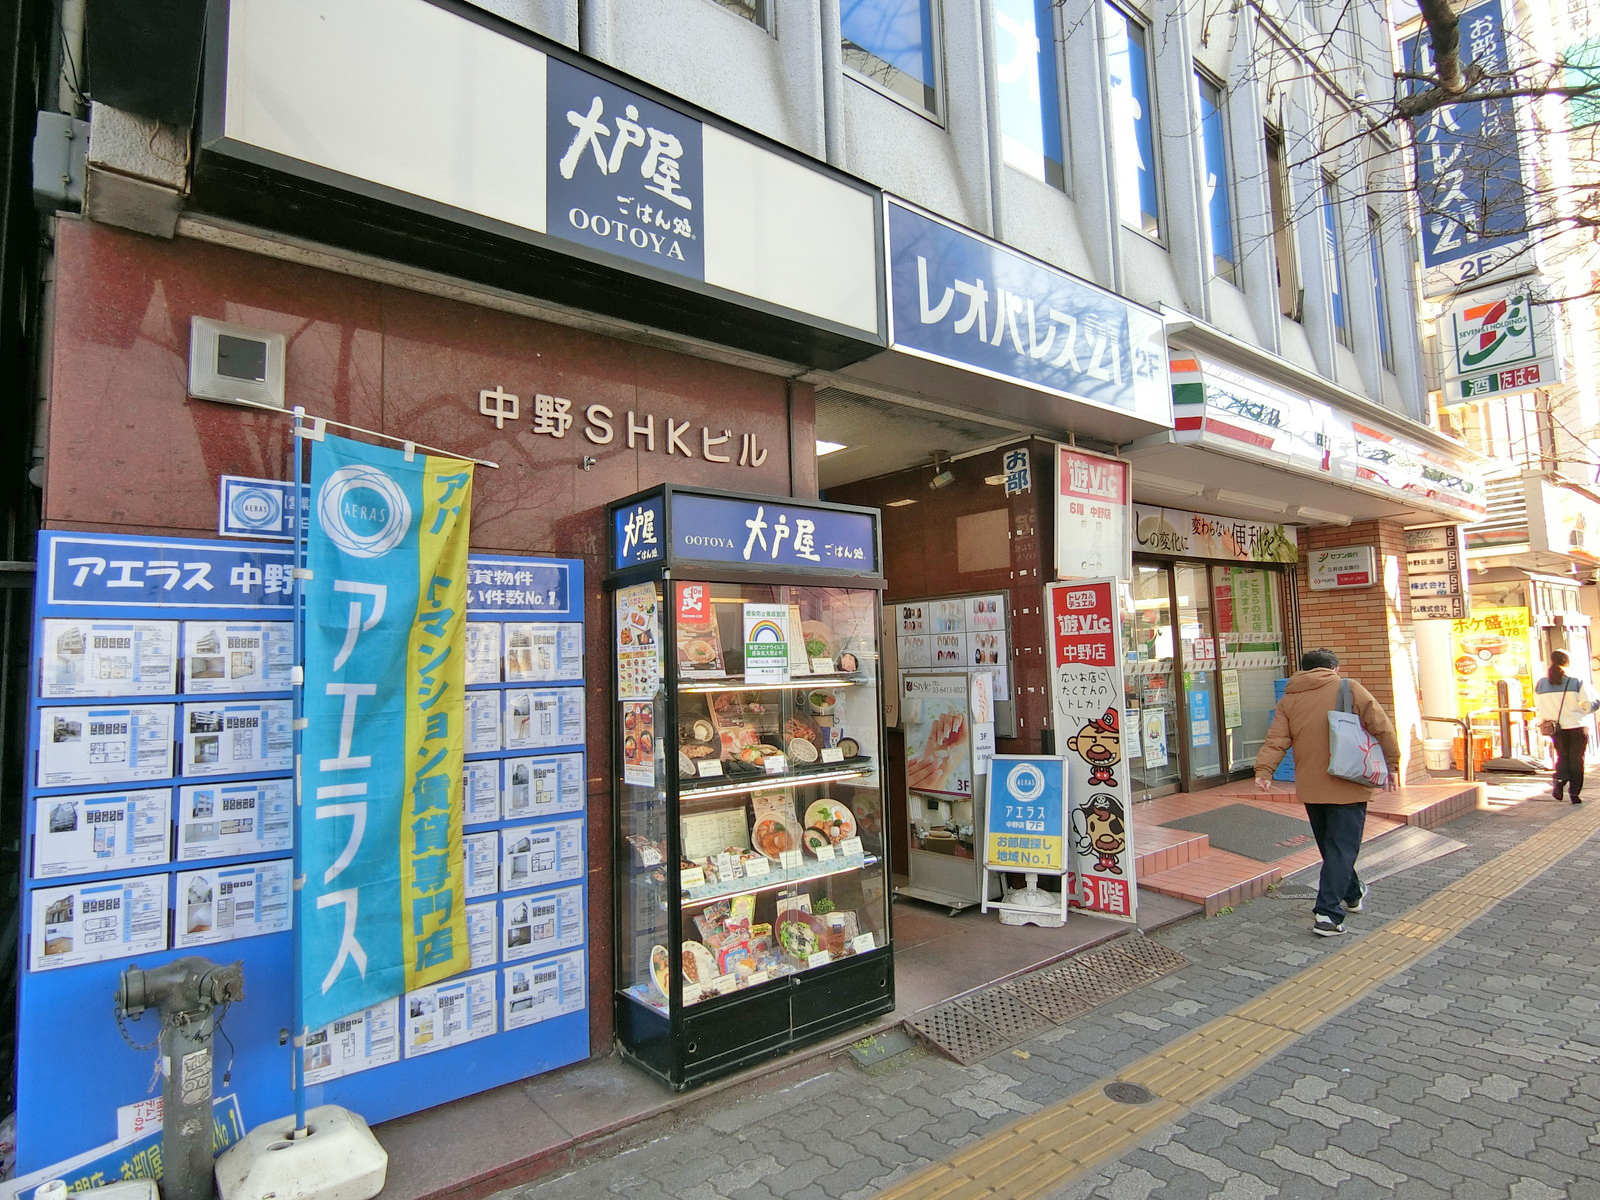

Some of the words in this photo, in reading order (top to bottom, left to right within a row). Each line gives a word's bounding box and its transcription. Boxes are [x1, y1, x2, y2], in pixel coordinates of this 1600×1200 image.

[559, 96, 693, 211] 大戸屋
[617, 195, 692, 239] ごはん処
[568, 208, 686, 262] OOTOYA
[1459, 254, 1493, 281] 2F
[1490, 315, 1528, 333] HOLDINGS
[1468, 377, 1490, 396] 酒
[1501, 366, 1540, 389] たばこ
[478, 385, 770, 469] 中野SHKビル
[244, 504, 268, 513] AERAS
[344, 502, 387, 523] AERAS
[1069, 502, 1085, 516] 6階
[1090, 506, 1112, 520] 中野店
[622, 506, 658, 558] 大戸屋
[685, 534, 734, 549] OOTOYA
[743, 505, 821, 562] 大戸屋
[68, 556, 215, 591] アエラス
[230, 562, 306, 595] 中野
[1063, 643, 1106, 661] 中野店
[1061, 685, 1108, 696] たくさんの
[979, 732, 988, 741] 3F
[315, 578, 388, 996] アエラス
[957, 779, 970, 792] 3F
[1017, 778, 1035, 786] AERAS
[1005, 805, 1045, 819] アエラス
[997, 836, 1052, 850] お部屋探し
